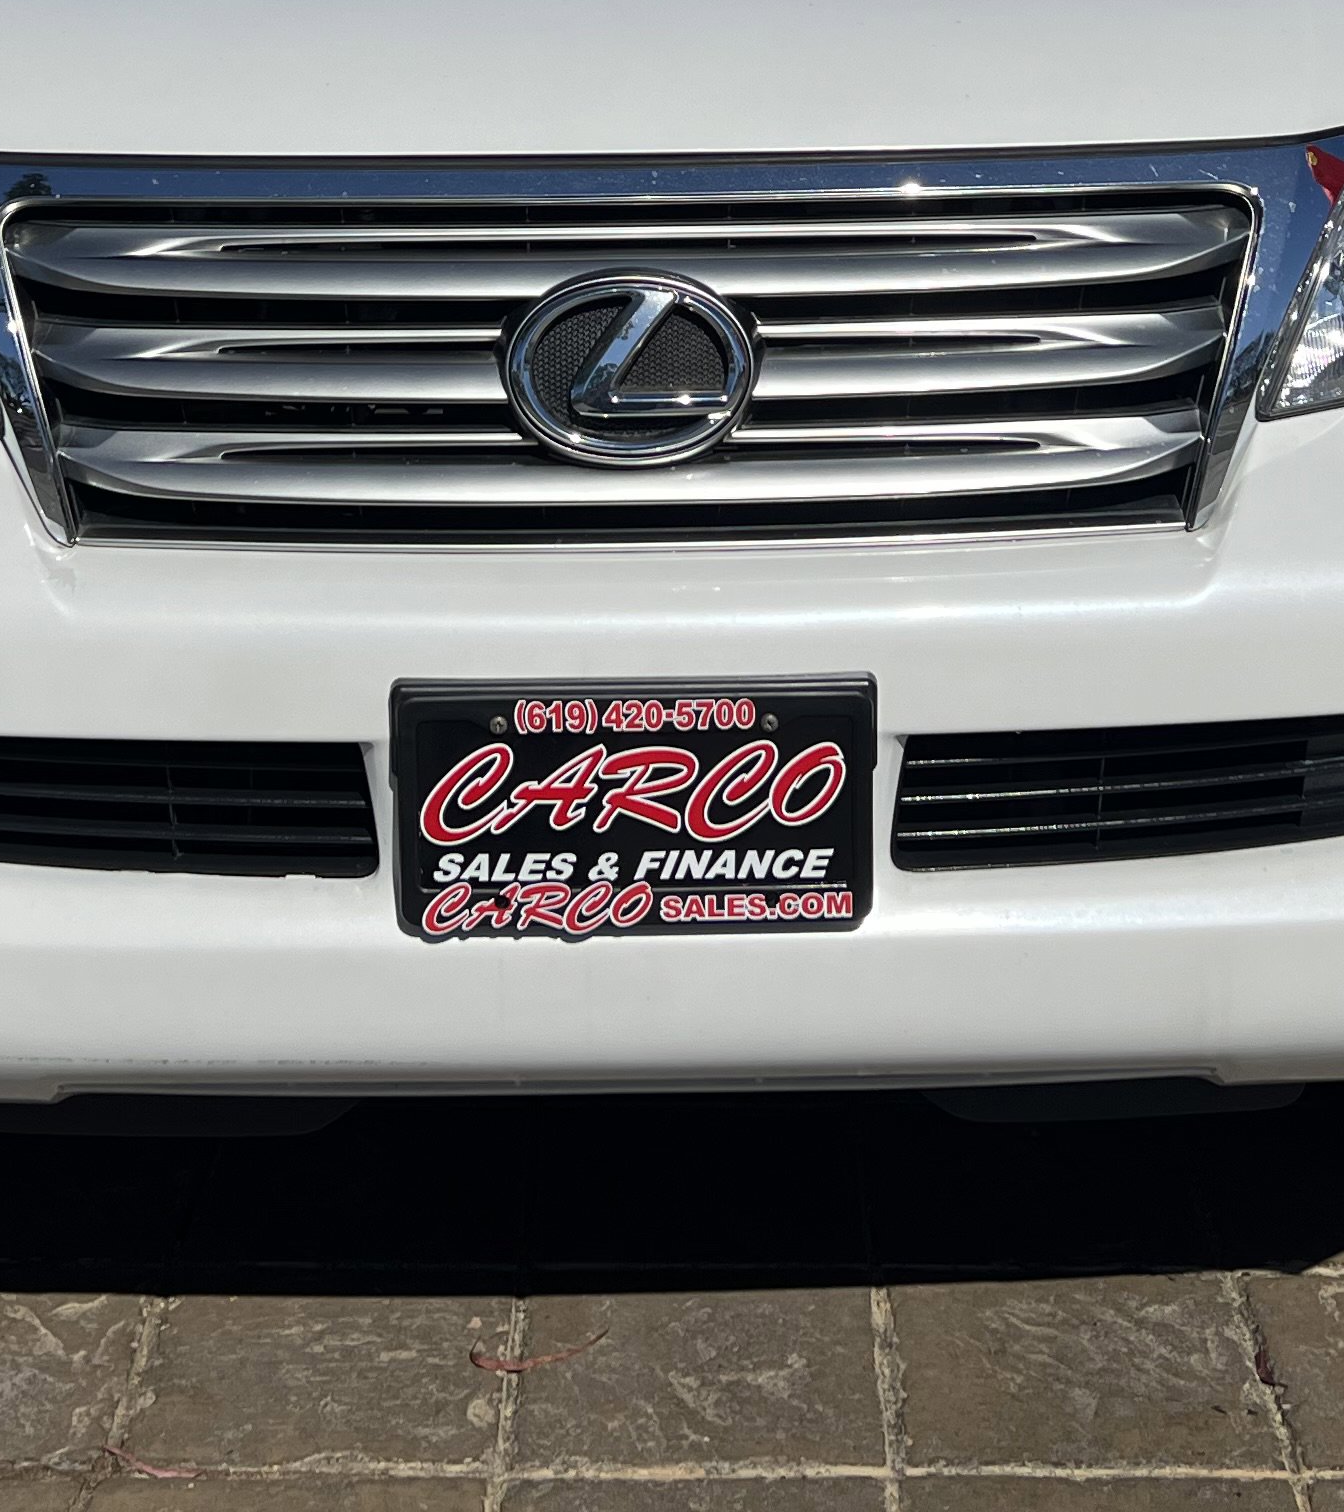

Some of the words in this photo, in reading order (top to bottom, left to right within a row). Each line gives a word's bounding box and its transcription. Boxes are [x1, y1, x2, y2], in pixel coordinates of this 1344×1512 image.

[514, 699, 598, 735] (619)
[601, 698, 756, 732] 420-5700
[420, 739, 845, 844] CARCO
[433, 851, 577, 883] SALES
[588, 851, 619, 882] &
[634, 848, 834, 879] FINANCE
[421, 881, 653, 936] CARCO
[660, 891, 854, 922] SALES.COM
